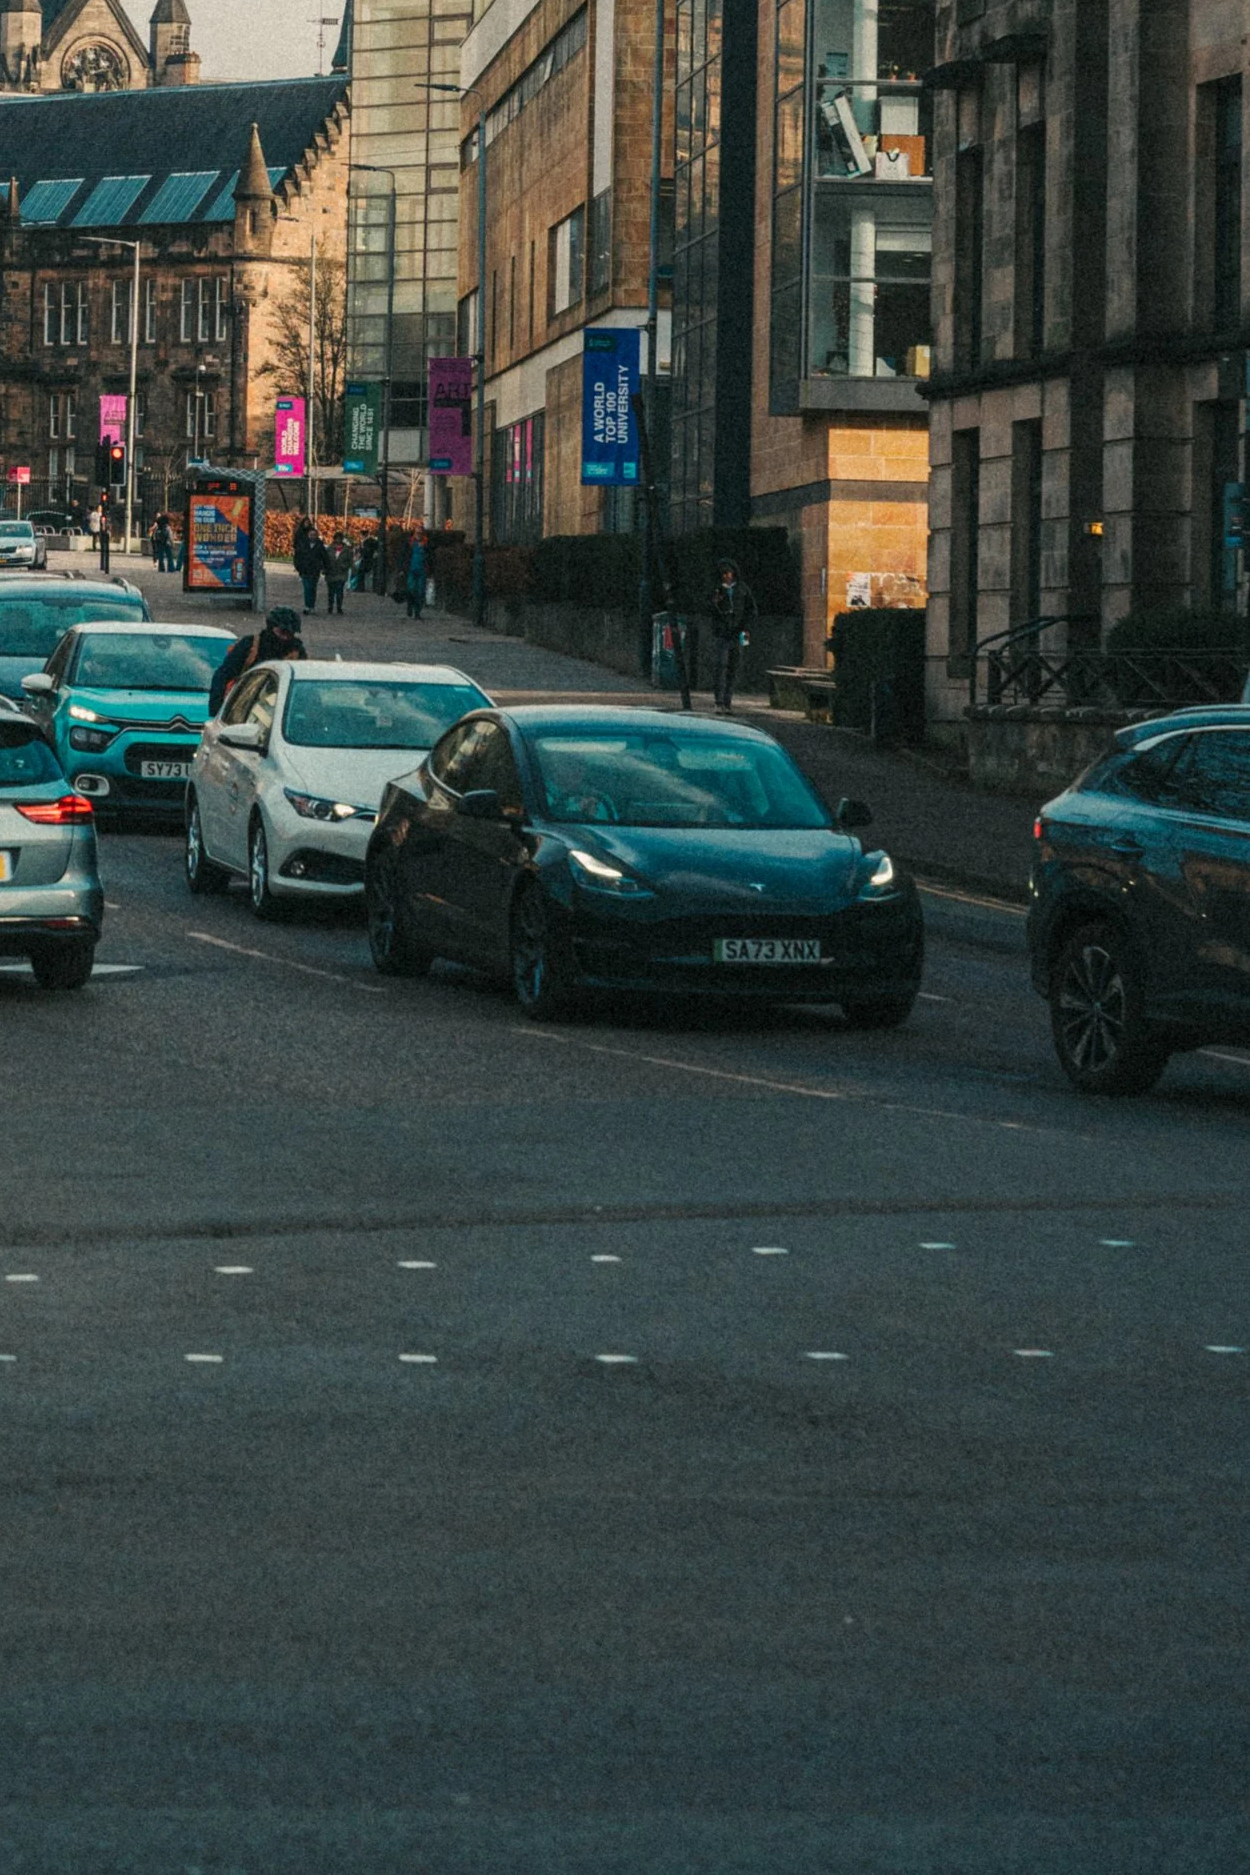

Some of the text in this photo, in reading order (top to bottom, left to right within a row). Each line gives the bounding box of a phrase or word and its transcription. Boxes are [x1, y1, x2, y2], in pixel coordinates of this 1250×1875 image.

[358, 403, 368, 451] THE WORLD
[593, 382, 605, 443] A WORLD
[605, 391, 617, 443] TOP 100
[617, 365, 630, 445] UNIVERSITY
[351, 407, 360, 451] CHANGING
[365, 426, 374, 451] SINCE
[147, 763, 182, 777] SY73
[725, 940, 817, 959] SA73 XNX
